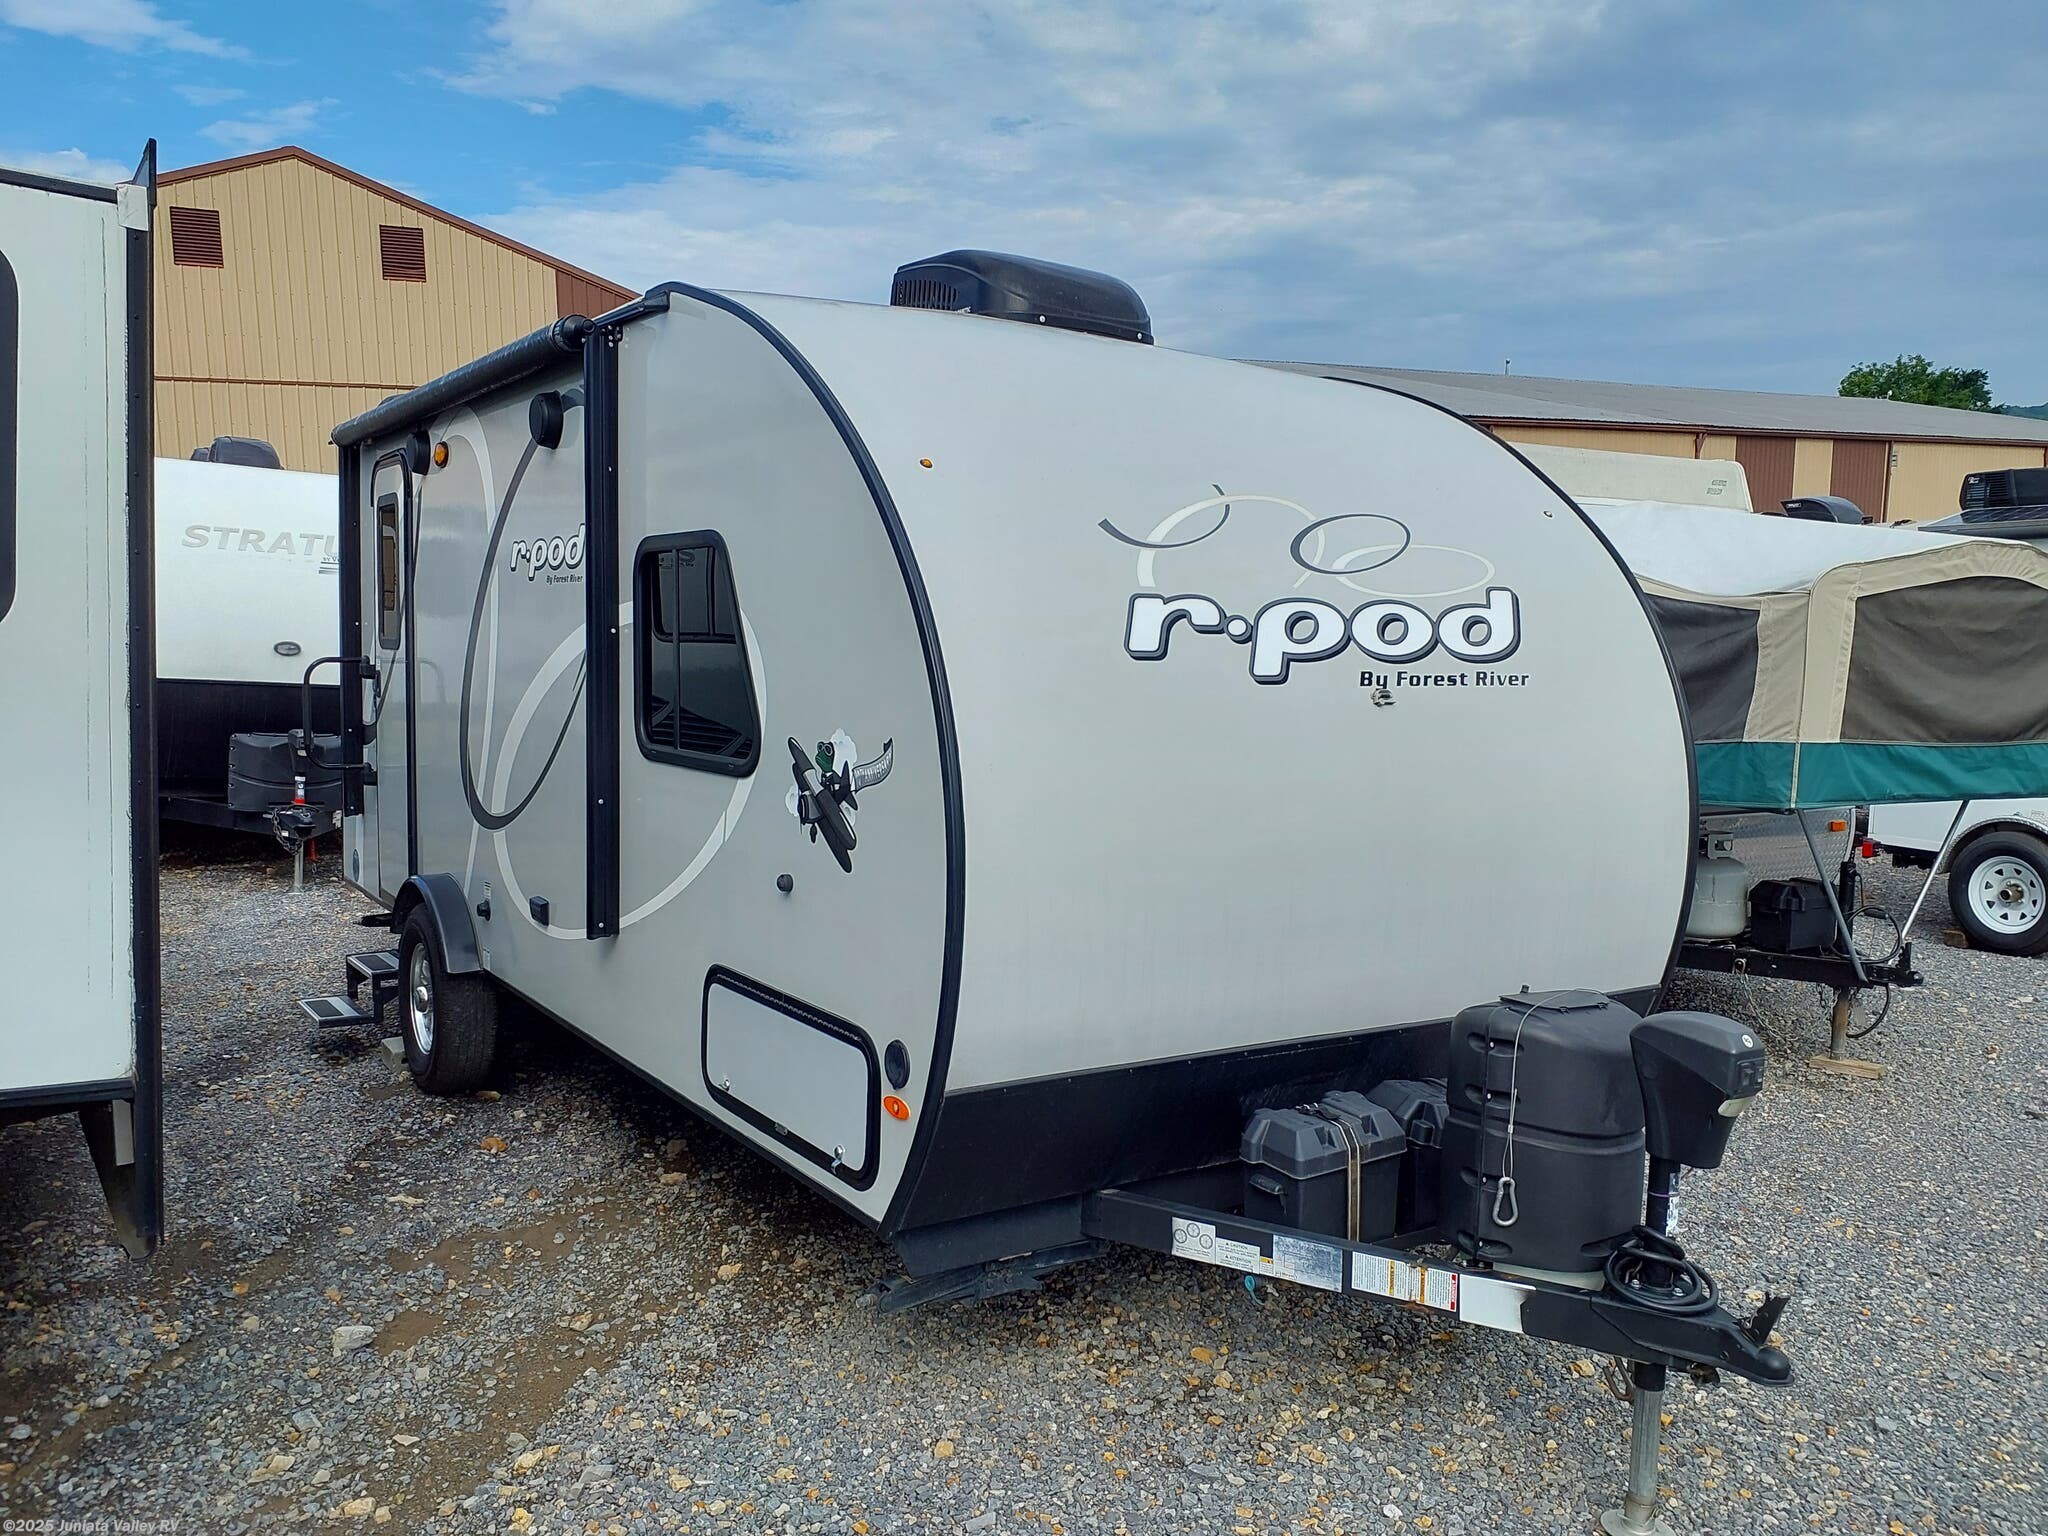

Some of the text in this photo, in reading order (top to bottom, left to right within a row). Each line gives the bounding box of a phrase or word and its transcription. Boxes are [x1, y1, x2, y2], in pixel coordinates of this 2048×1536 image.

[553, 574, 569, 584] Forest
[570, 573, 583, 583] River
[1359, 670, 1530, 689] By Forest River
